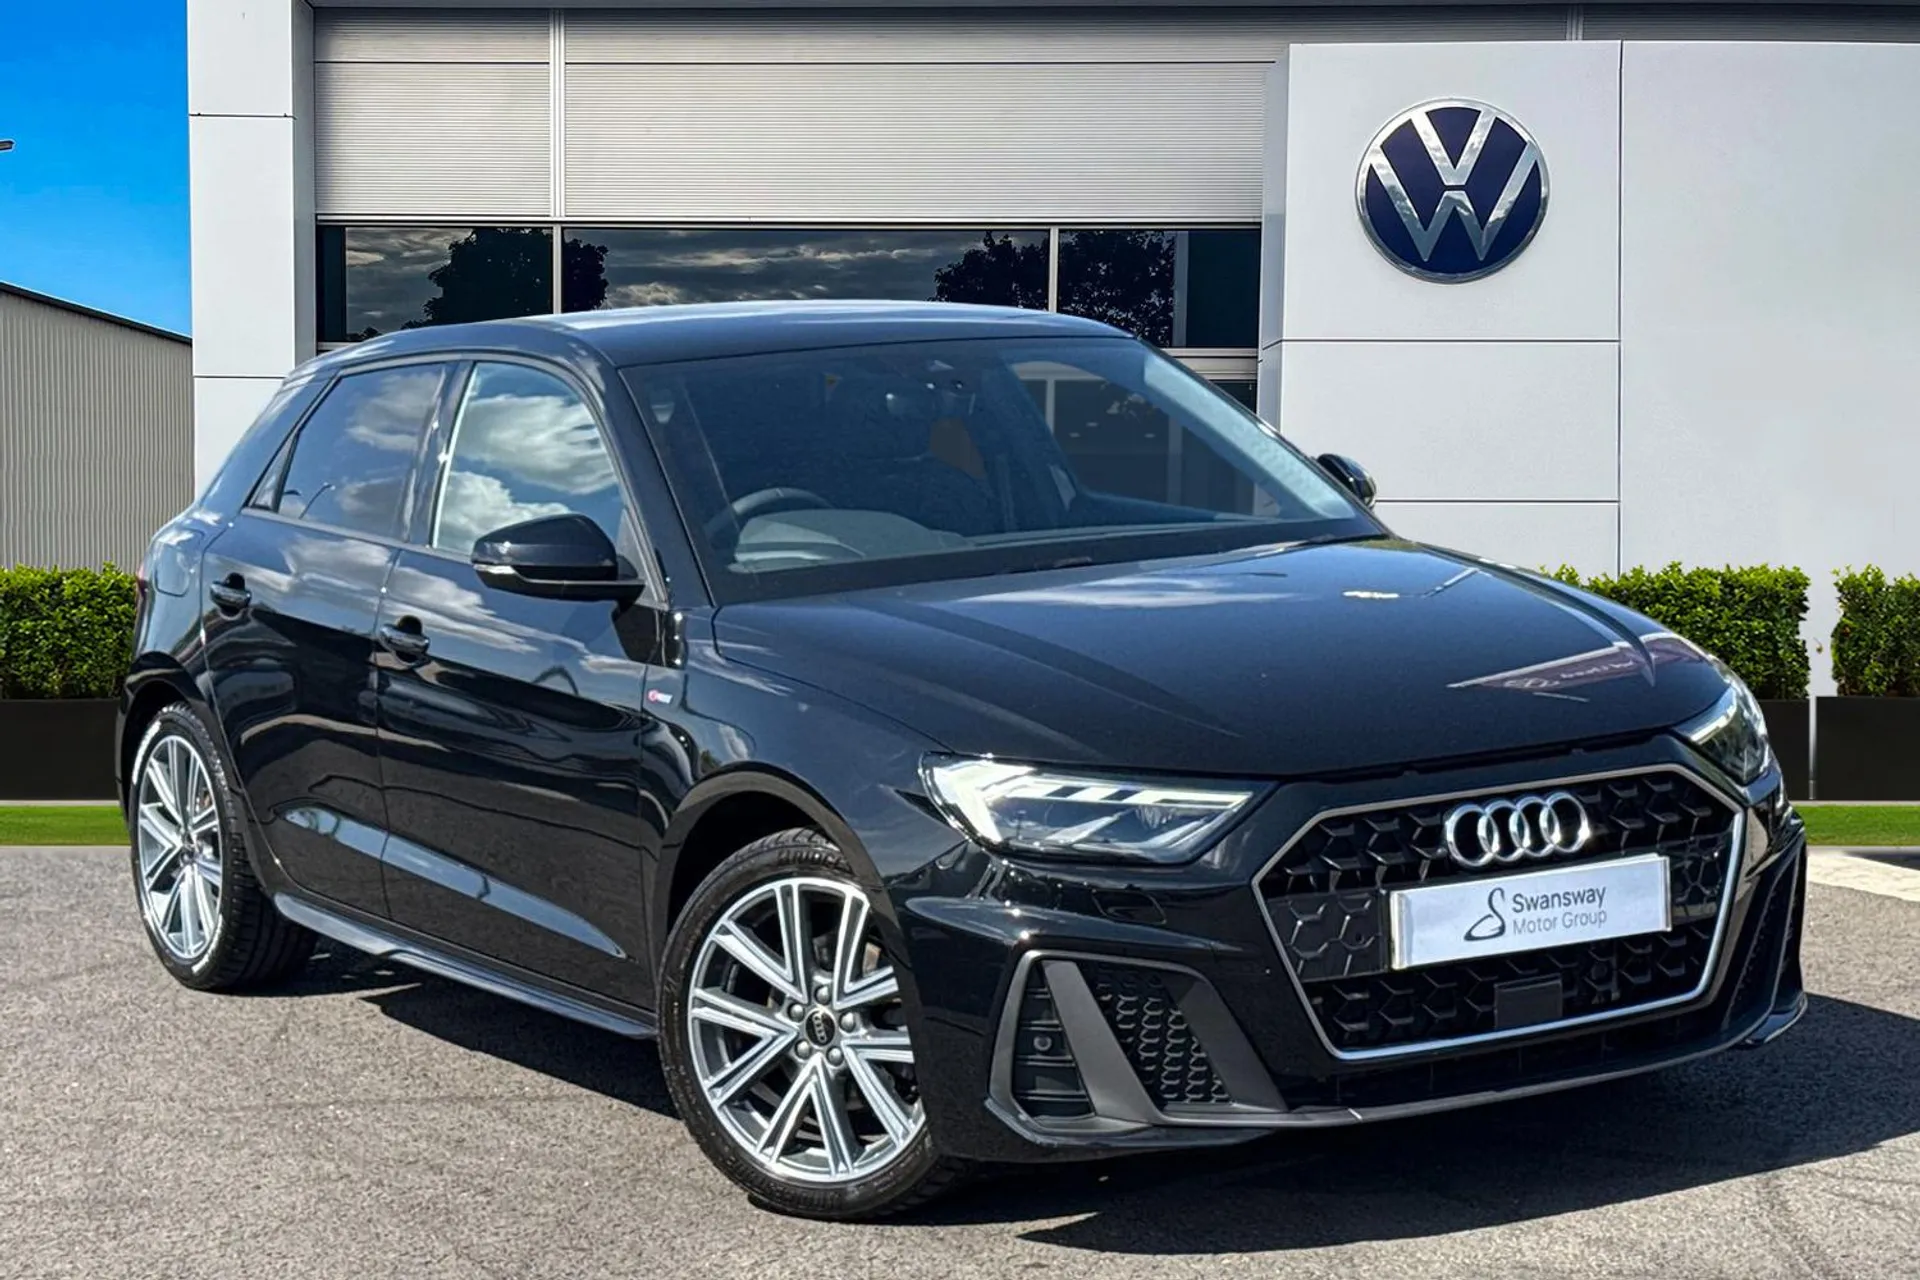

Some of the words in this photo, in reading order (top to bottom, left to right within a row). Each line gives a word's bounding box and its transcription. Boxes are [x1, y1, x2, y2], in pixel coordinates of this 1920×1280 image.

[1512, 886, 1606, 913] Swansway
[1513, 916, 1558, 936] Motor
[1562, 910, 1607, 928] Group
